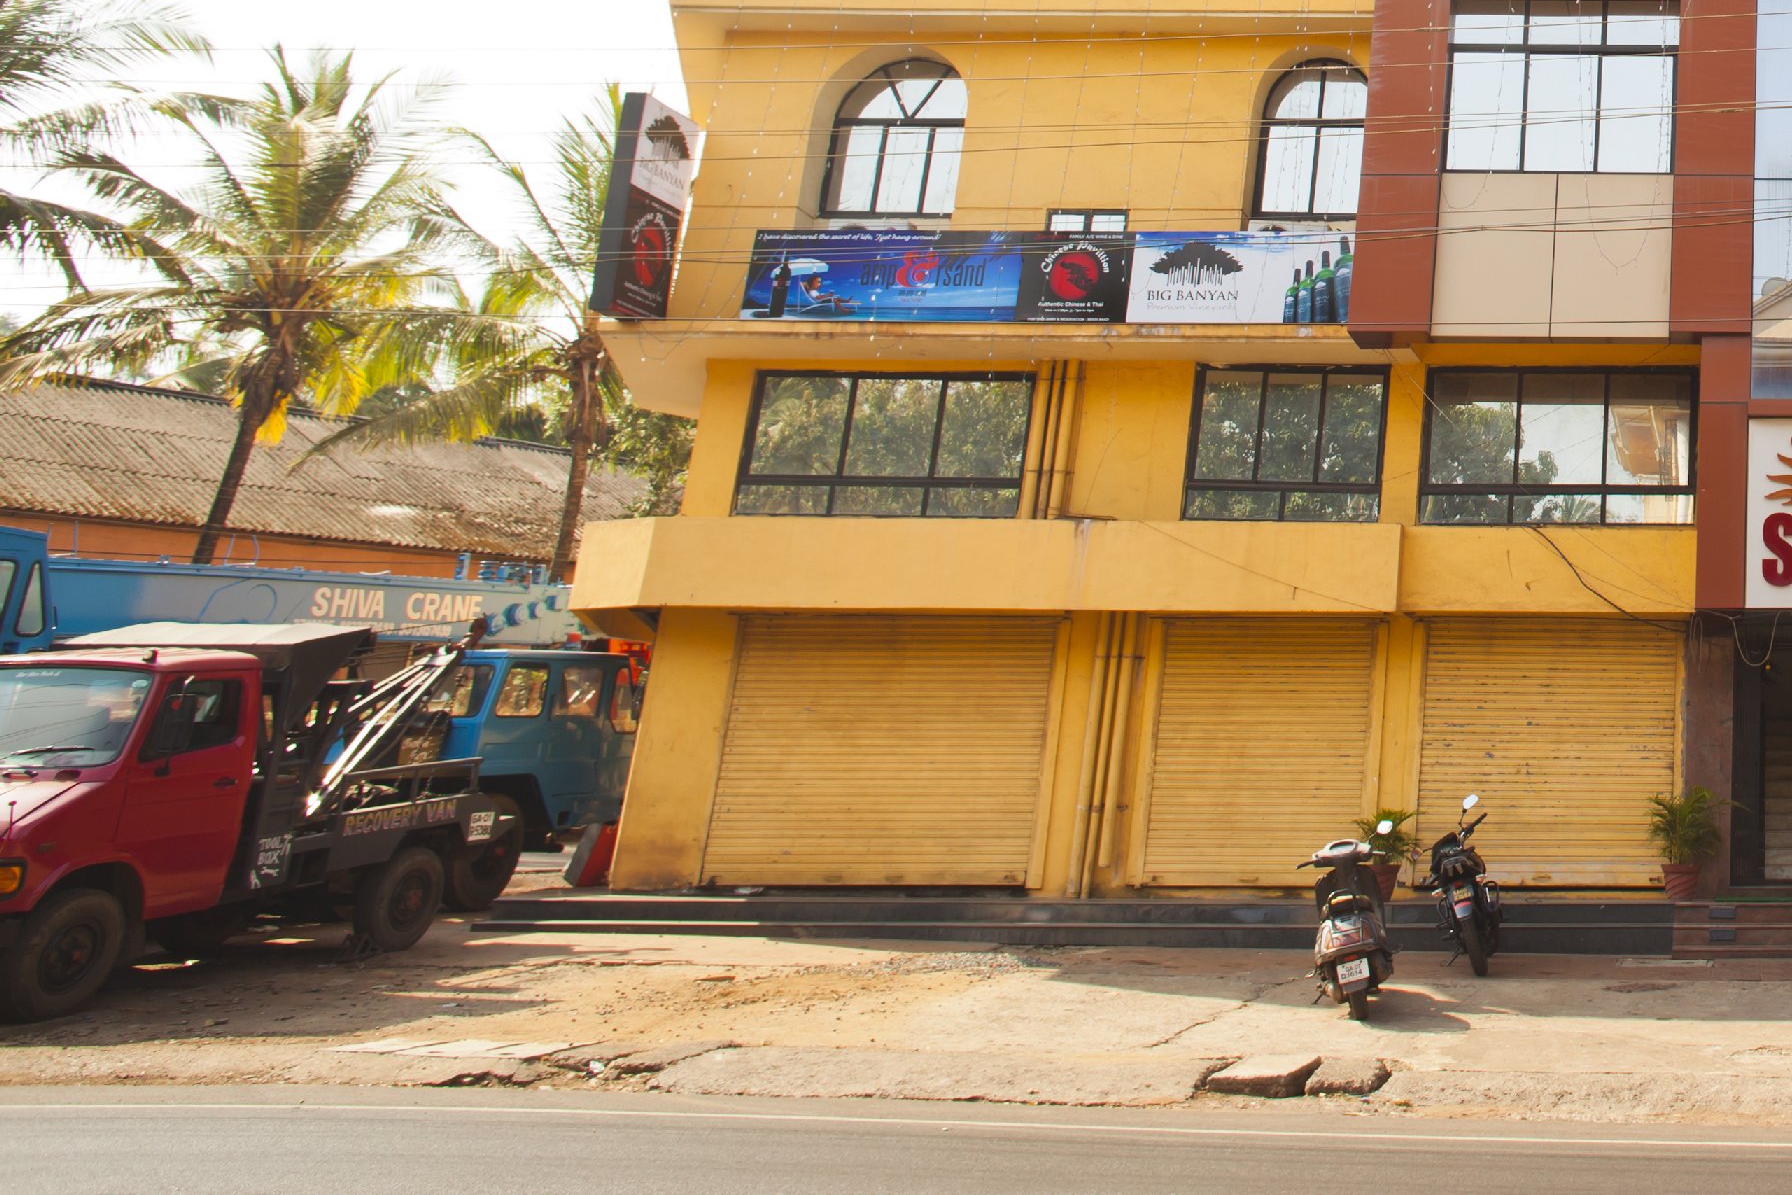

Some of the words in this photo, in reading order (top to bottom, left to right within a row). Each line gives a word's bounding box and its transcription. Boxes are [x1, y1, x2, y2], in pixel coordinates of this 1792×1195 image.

[1041, 243, 1074, 273] Chinese
[1147, 290, 1172, 301] BIG
[1176, 290, 1239, 301] BANYAN
[311, 586, 385, 619] SHIVA
[406, 592, 484, 622] CRANE
[342, 805, 422, 837] RECOVERY
[426, 799, 458, 823] VAN
[259, 837, 283, 850] TOOL
[257, 851, 281, 865] BOX
